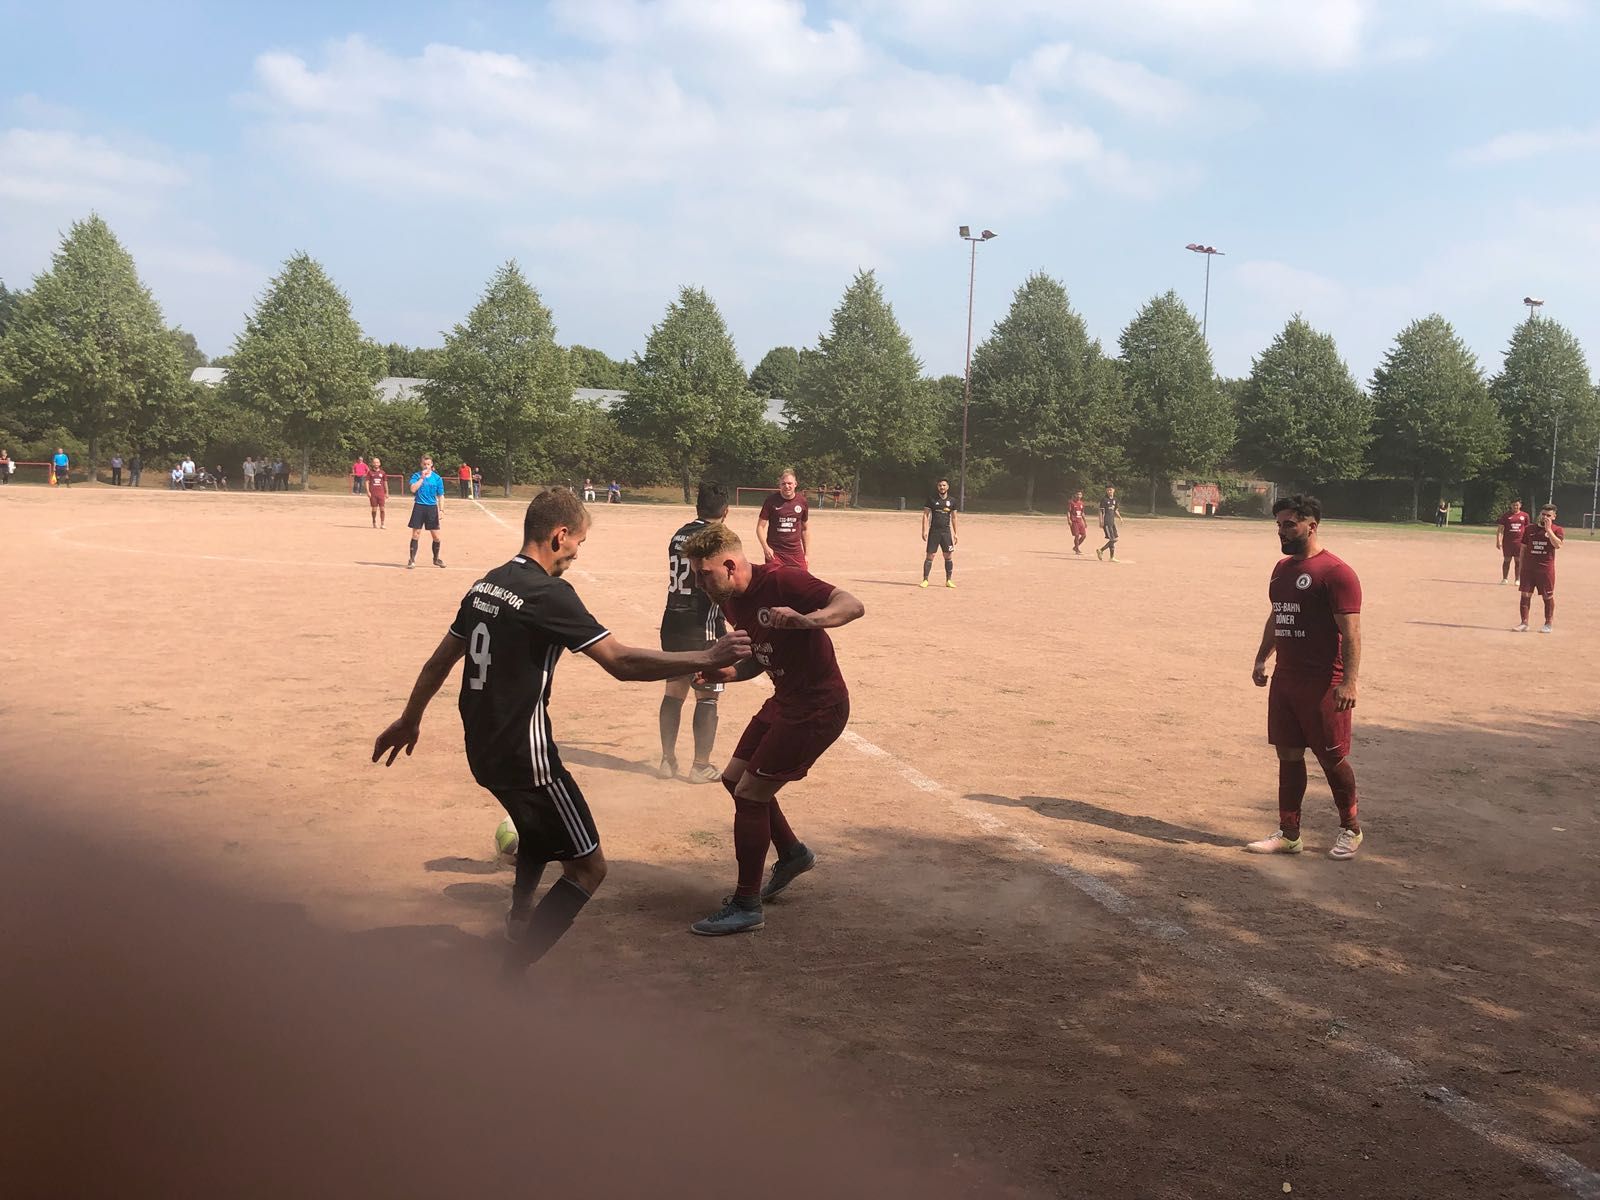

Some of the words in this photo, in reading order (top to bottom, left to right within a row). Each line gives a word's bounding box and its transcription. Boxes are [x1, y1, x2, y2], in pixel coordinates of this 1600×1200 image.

[473, 597, 500, 618] Hamburg
[1276, 613, 1295, 624] DÖNER
[470, 622, 491, 690] 9
